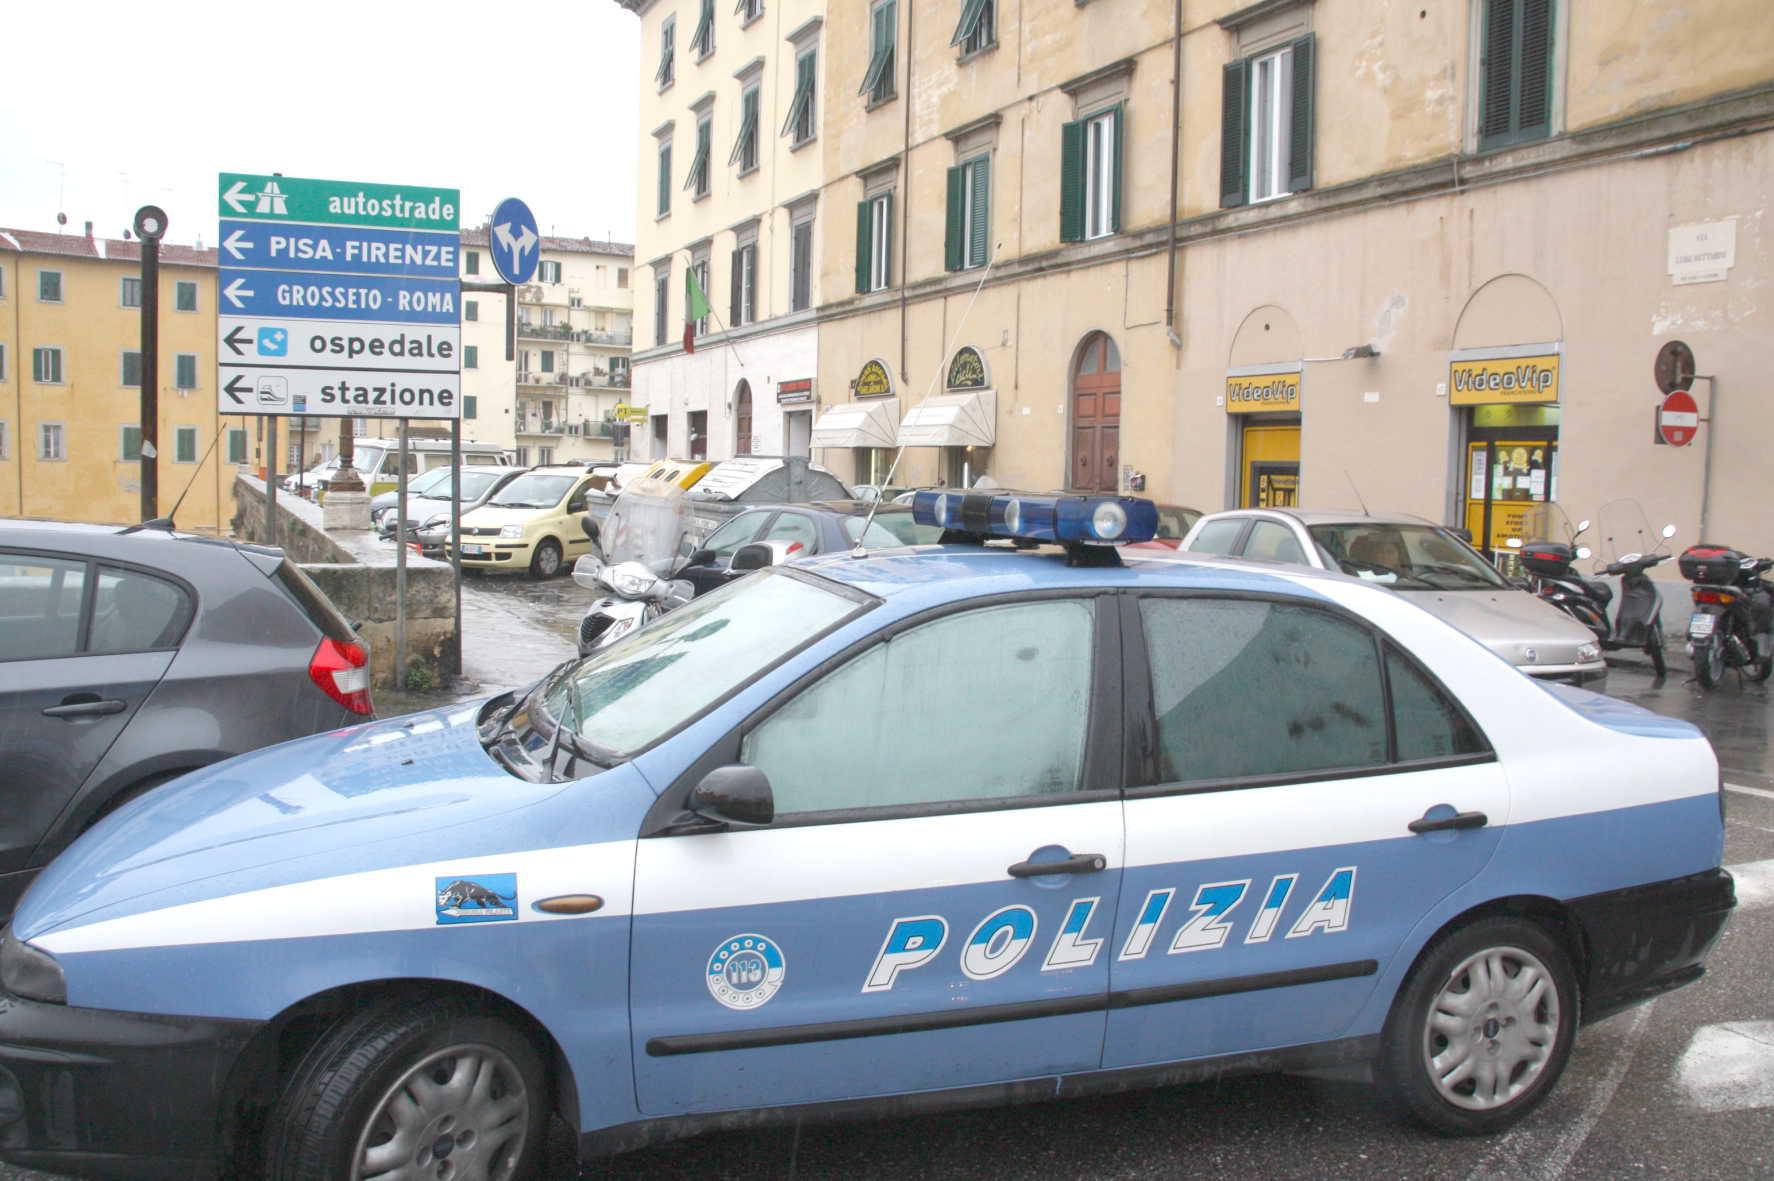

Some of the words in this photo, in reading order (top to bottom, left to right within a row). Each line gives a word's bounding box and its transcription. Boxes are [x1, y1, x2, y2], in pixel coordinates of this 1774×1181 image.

[329, 193, 455, 221] autostrade
[270, 236, 333, 260] PISA
[345, 240, 454, 267] FIRENZE
[277, 284, 381, 310] GROSSETO
[398, 290, 454, 313] ROMA
[309, 333, 454, 359] ospedale
[1454, 365, 1553, 394] VideoVip
[320, 380, 454, 408] stazione
[861, 865, 1358, 993] POLIZIA
[729, 959, 762, 985] 113
